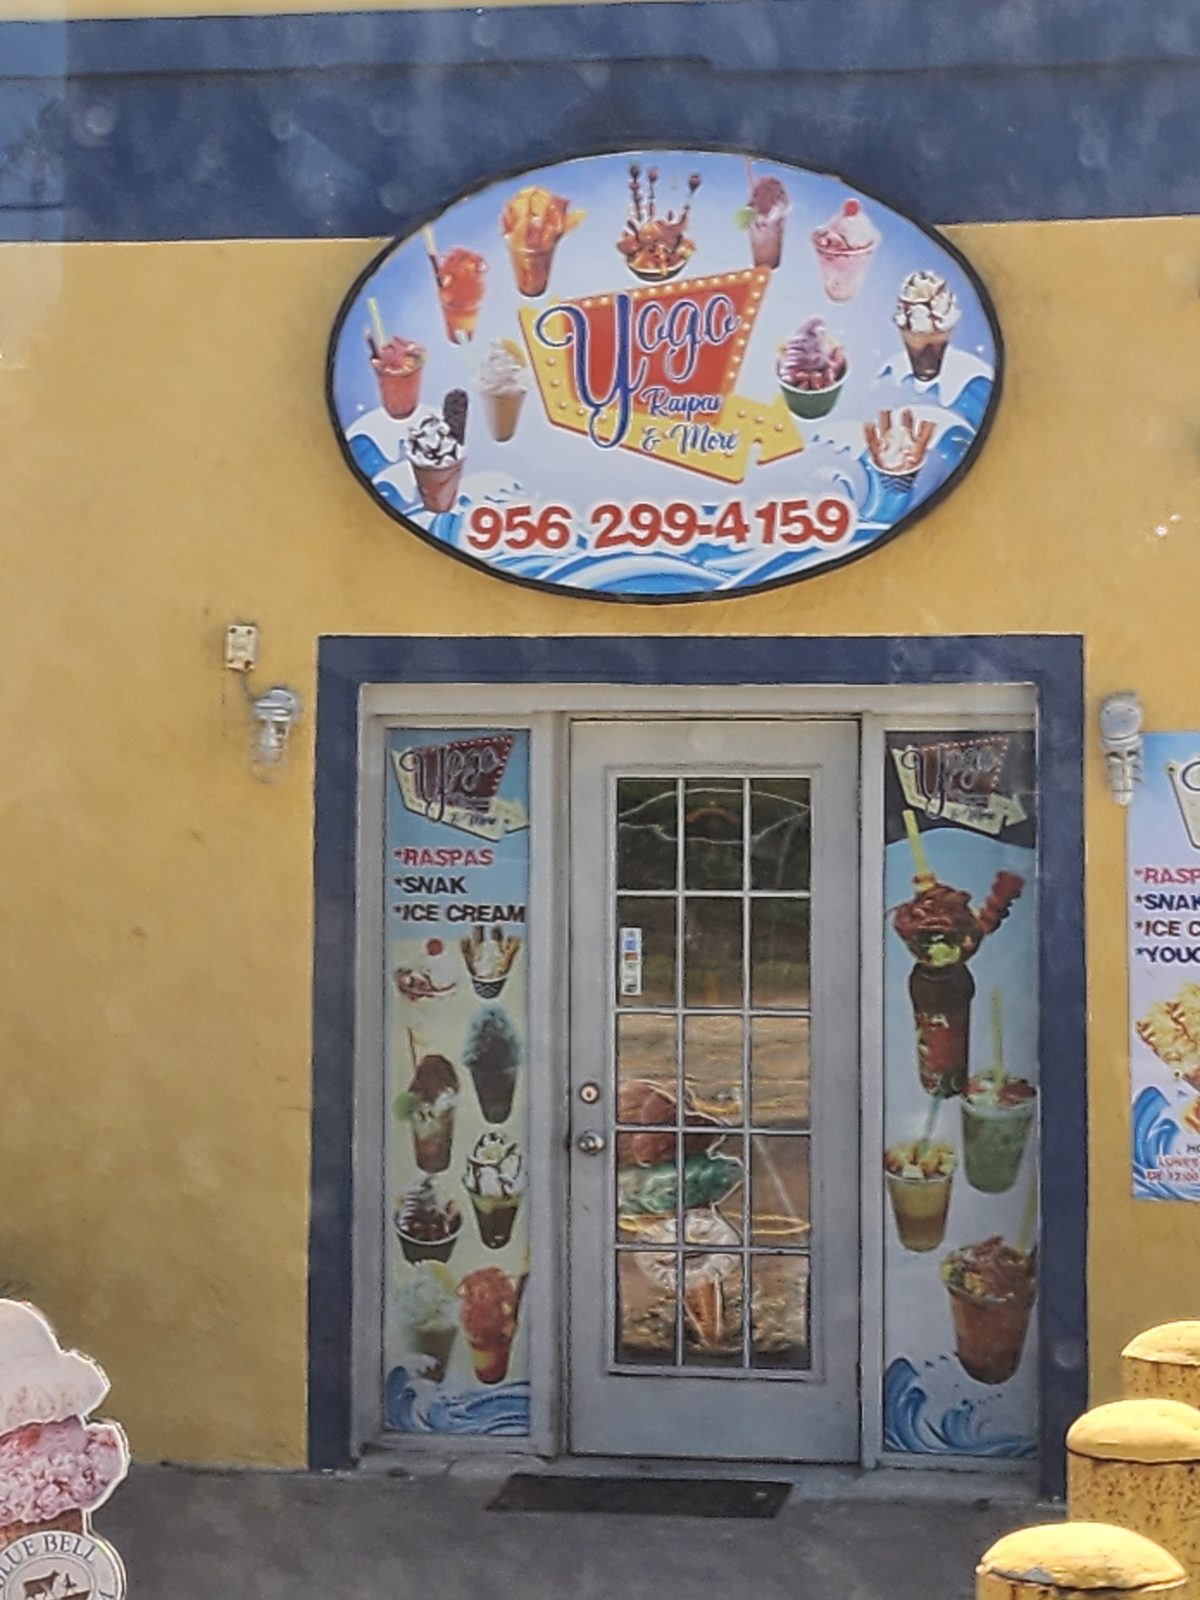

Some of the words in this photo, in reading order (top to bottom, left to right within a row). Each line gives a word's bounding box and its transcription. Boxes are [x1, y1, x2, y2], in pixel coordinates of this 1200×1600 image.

[641, 427, 662, 452] &
[669, 423, 739, 455] More
[466, 505, 573, 551] 956
[445, 904, 527, 924] CREAM
